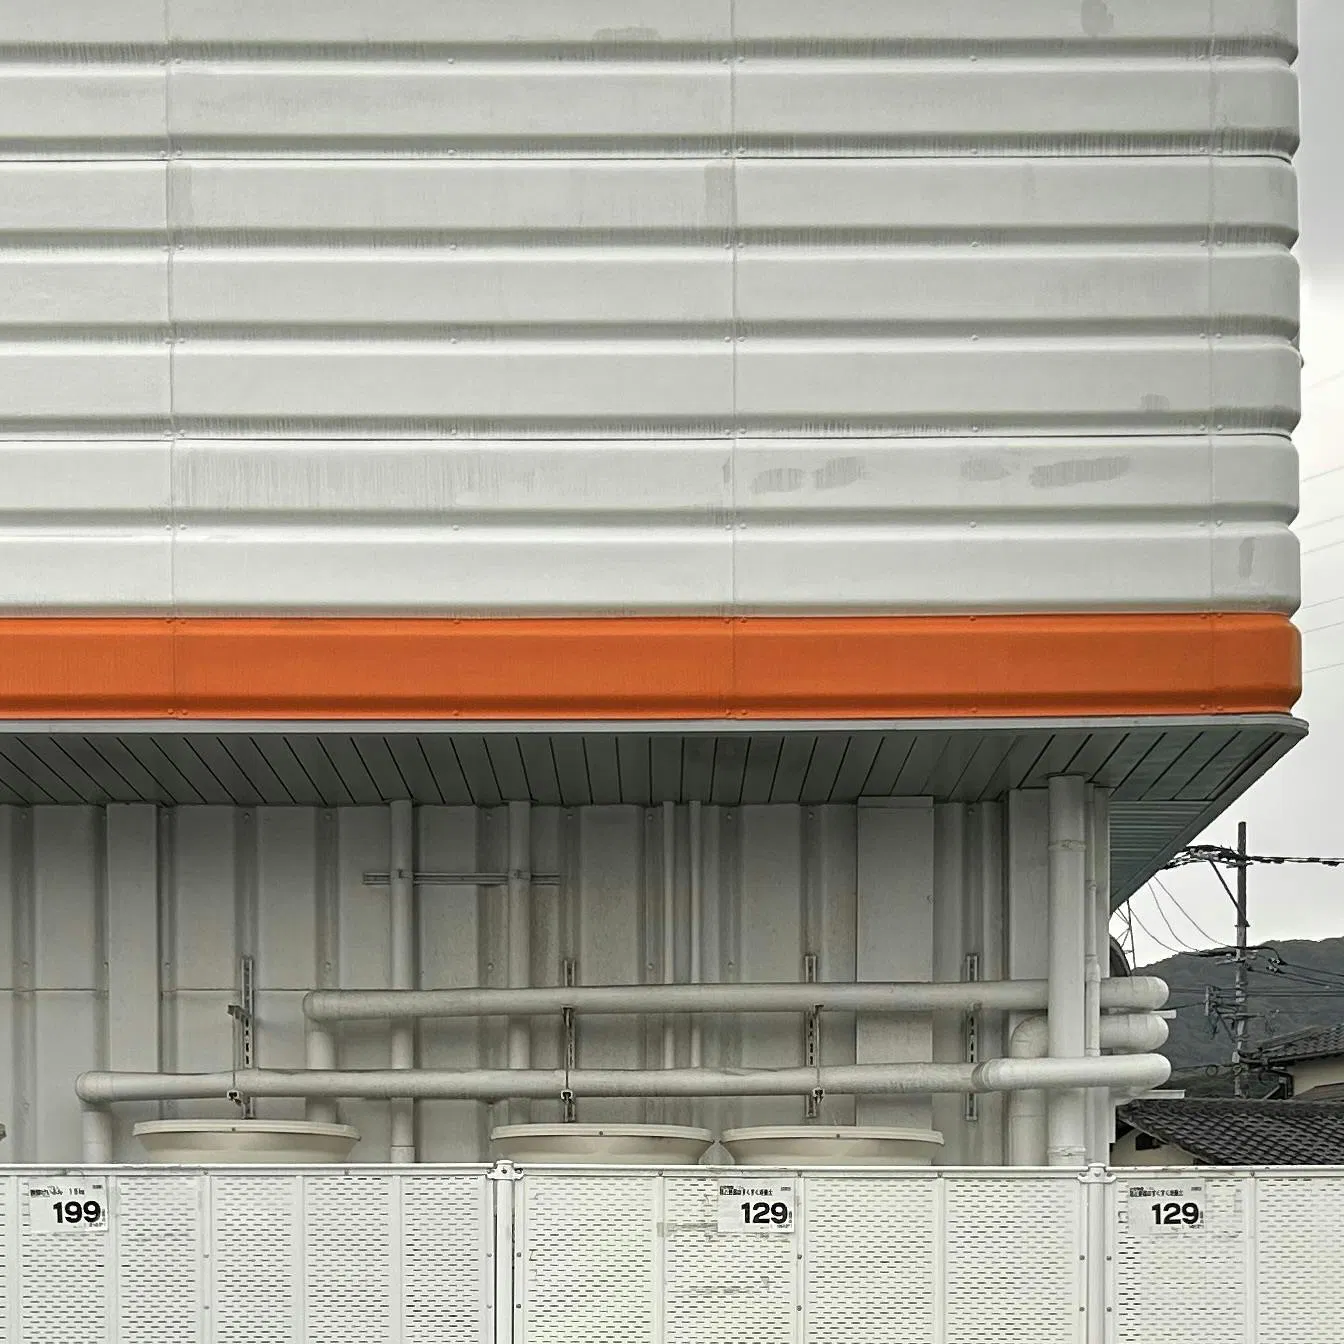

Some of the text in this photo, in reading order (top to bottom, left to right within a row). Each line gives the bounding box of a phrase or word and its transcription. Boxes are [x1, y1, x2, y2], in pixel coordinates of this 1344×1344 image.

[53, 1200, 101, 1223] 199
[741, 1202, 788, 1224] 129
[1152, 1202, 1199, 1224] 129
